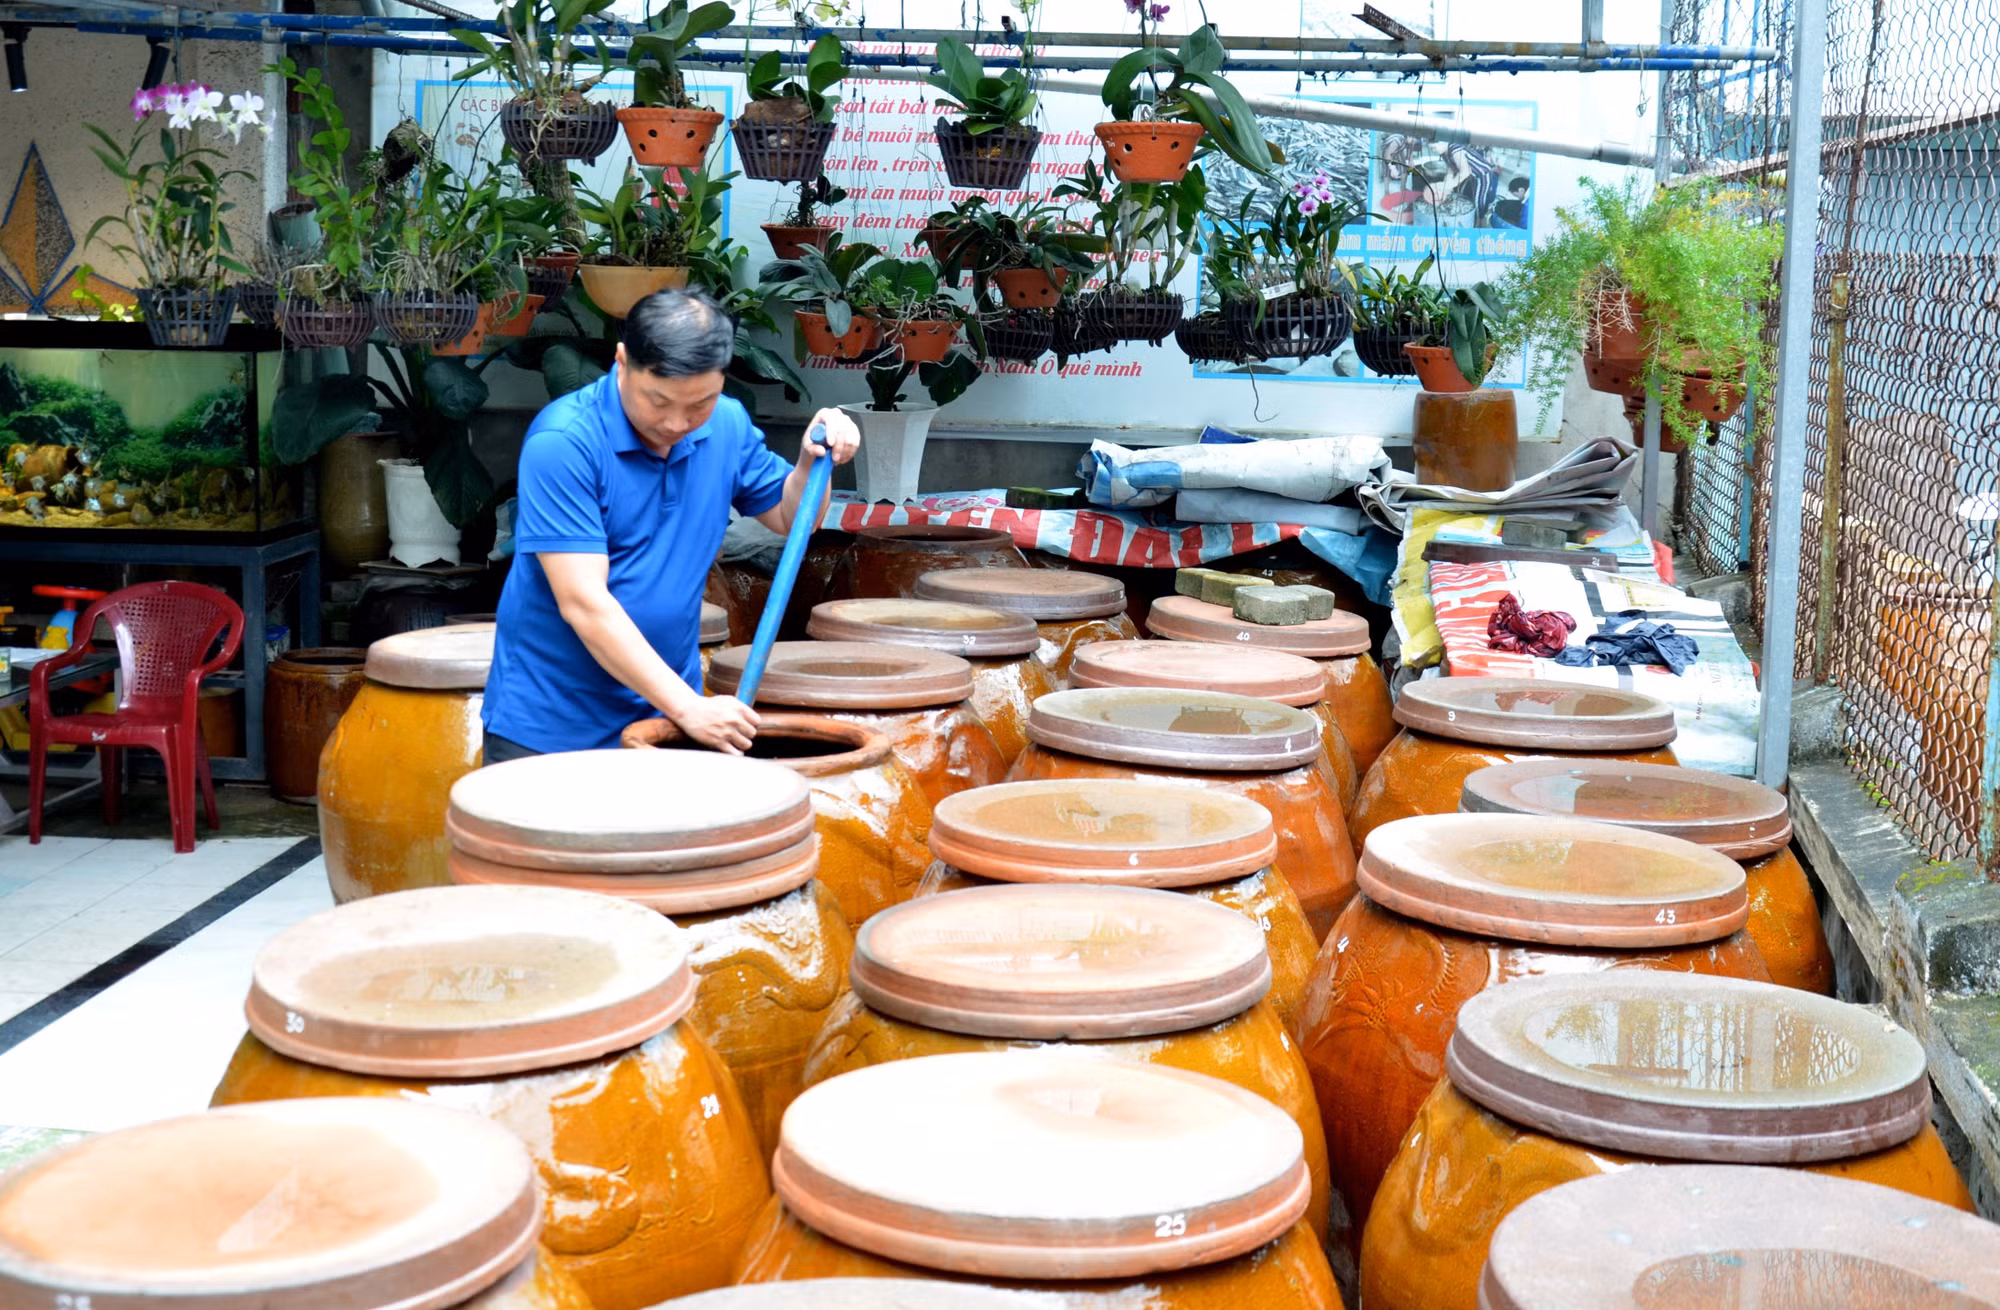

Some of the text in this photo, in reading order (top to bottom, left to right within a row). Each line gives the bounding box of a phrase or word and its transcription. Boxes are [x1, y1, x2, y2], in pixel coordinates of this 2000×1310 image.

[460, 96, 487, 112] CÁC
[868, 94, 895, 114] tất
[898, 98, 929, 118] bật
[867, 124, 914, 143] muối
[851, 155, 878, 171] lên
[892, 156, 930, 175] trộn
[870, 185, 895, 200] ăn
[899, 182, 945, 201] muối
[948, 189, 1001, 207] mang
[852, 212, 892, 229] đêm
[1477, 230, 1528, 259] thống
[1040, 355, 1055, 375] Ô
[1057, 359, 1091, 379] quê
[1093, 359, 1143, 377] mình
[1235, 631, 1250, 641] 40
[1448, 710, 1456, 722] 9
[1654, 907, 1677, 925] 43
[285, 1011, 305, 1034] 30
[1155, 1212, 1187, 1238] 25
